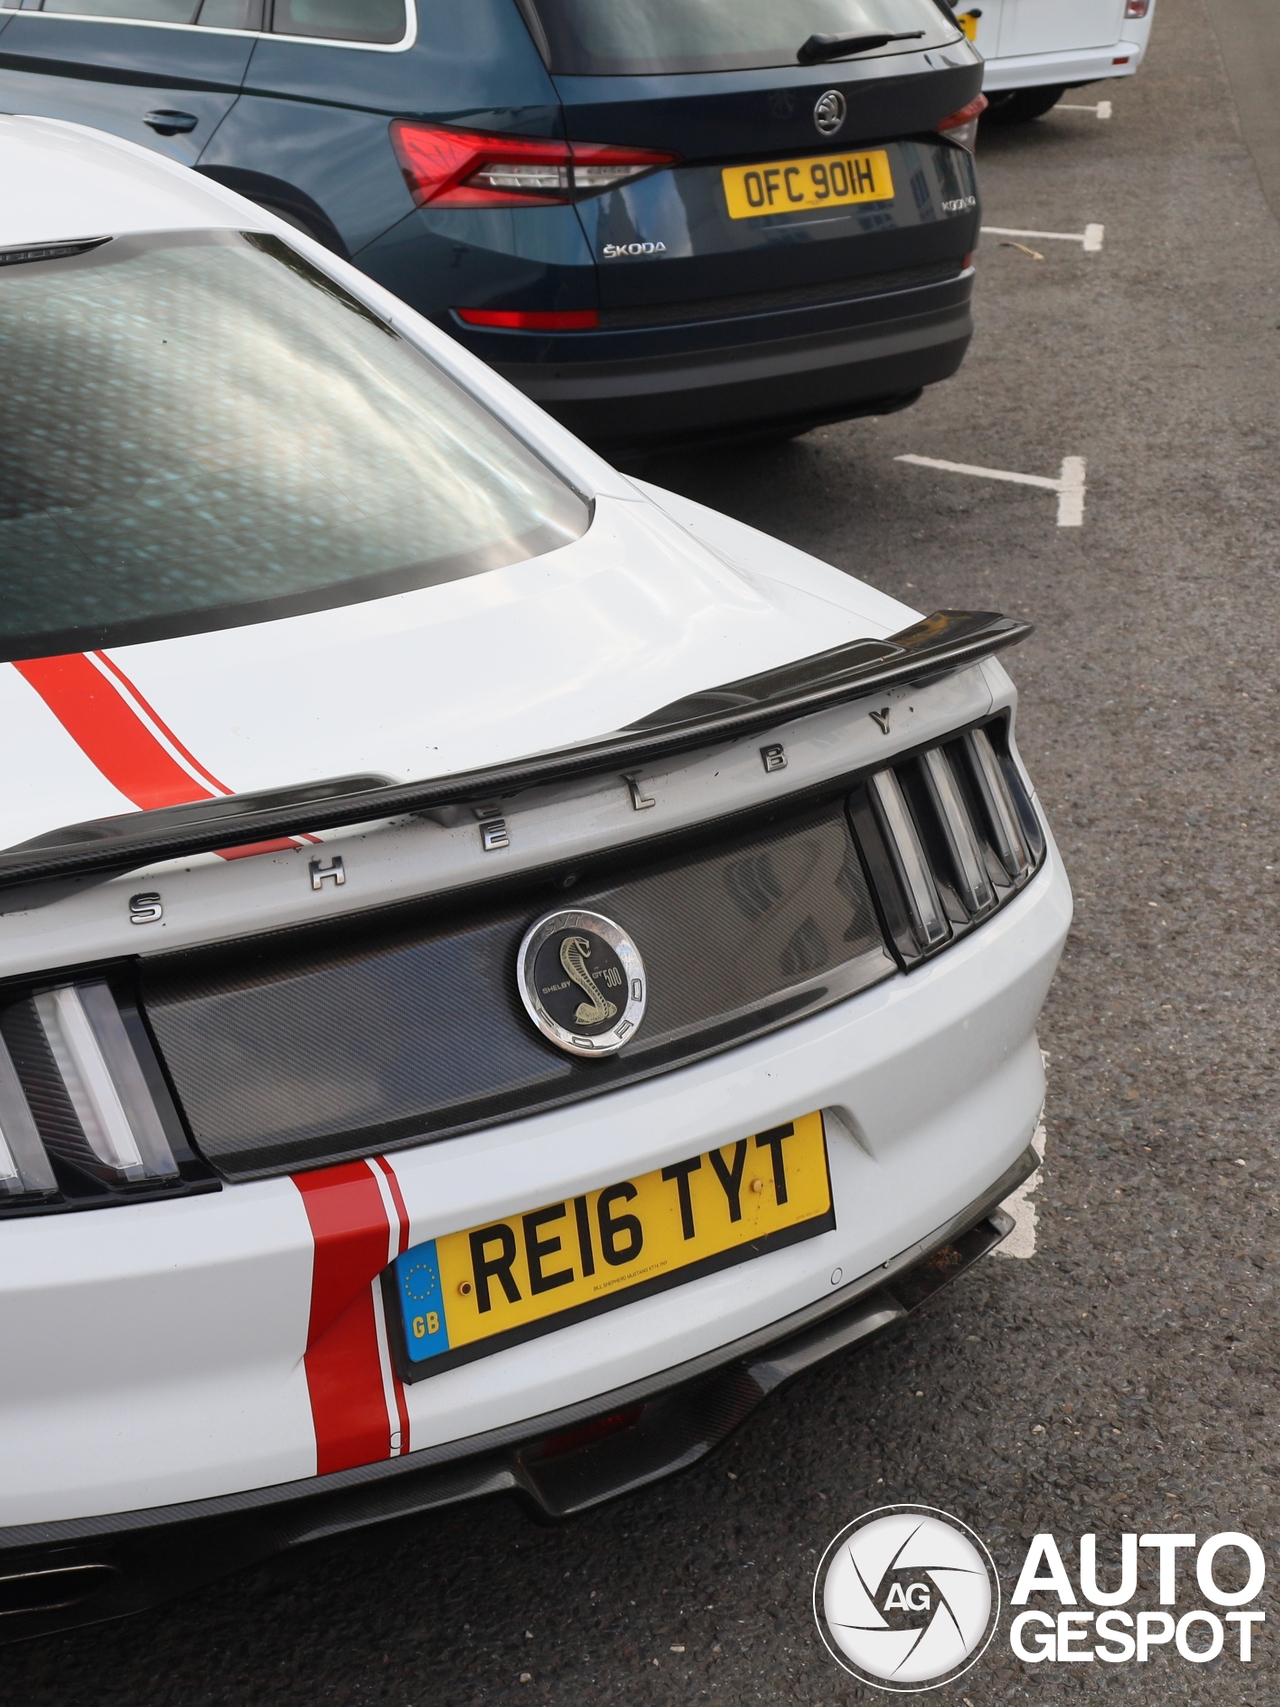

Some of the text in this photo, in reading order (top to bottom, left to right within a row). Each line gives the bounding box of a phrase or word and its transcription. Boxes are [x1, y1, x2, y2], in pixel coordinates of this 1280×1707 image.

[744, 157, 875, 208] OFC 901H
[129, 707, 891, 925] SHELBY
[541, 980, 572, 995] SHELBY
[468, 1121, 795, 1315] RE16 TYT
[412, 1311, 440, 1339] GB
